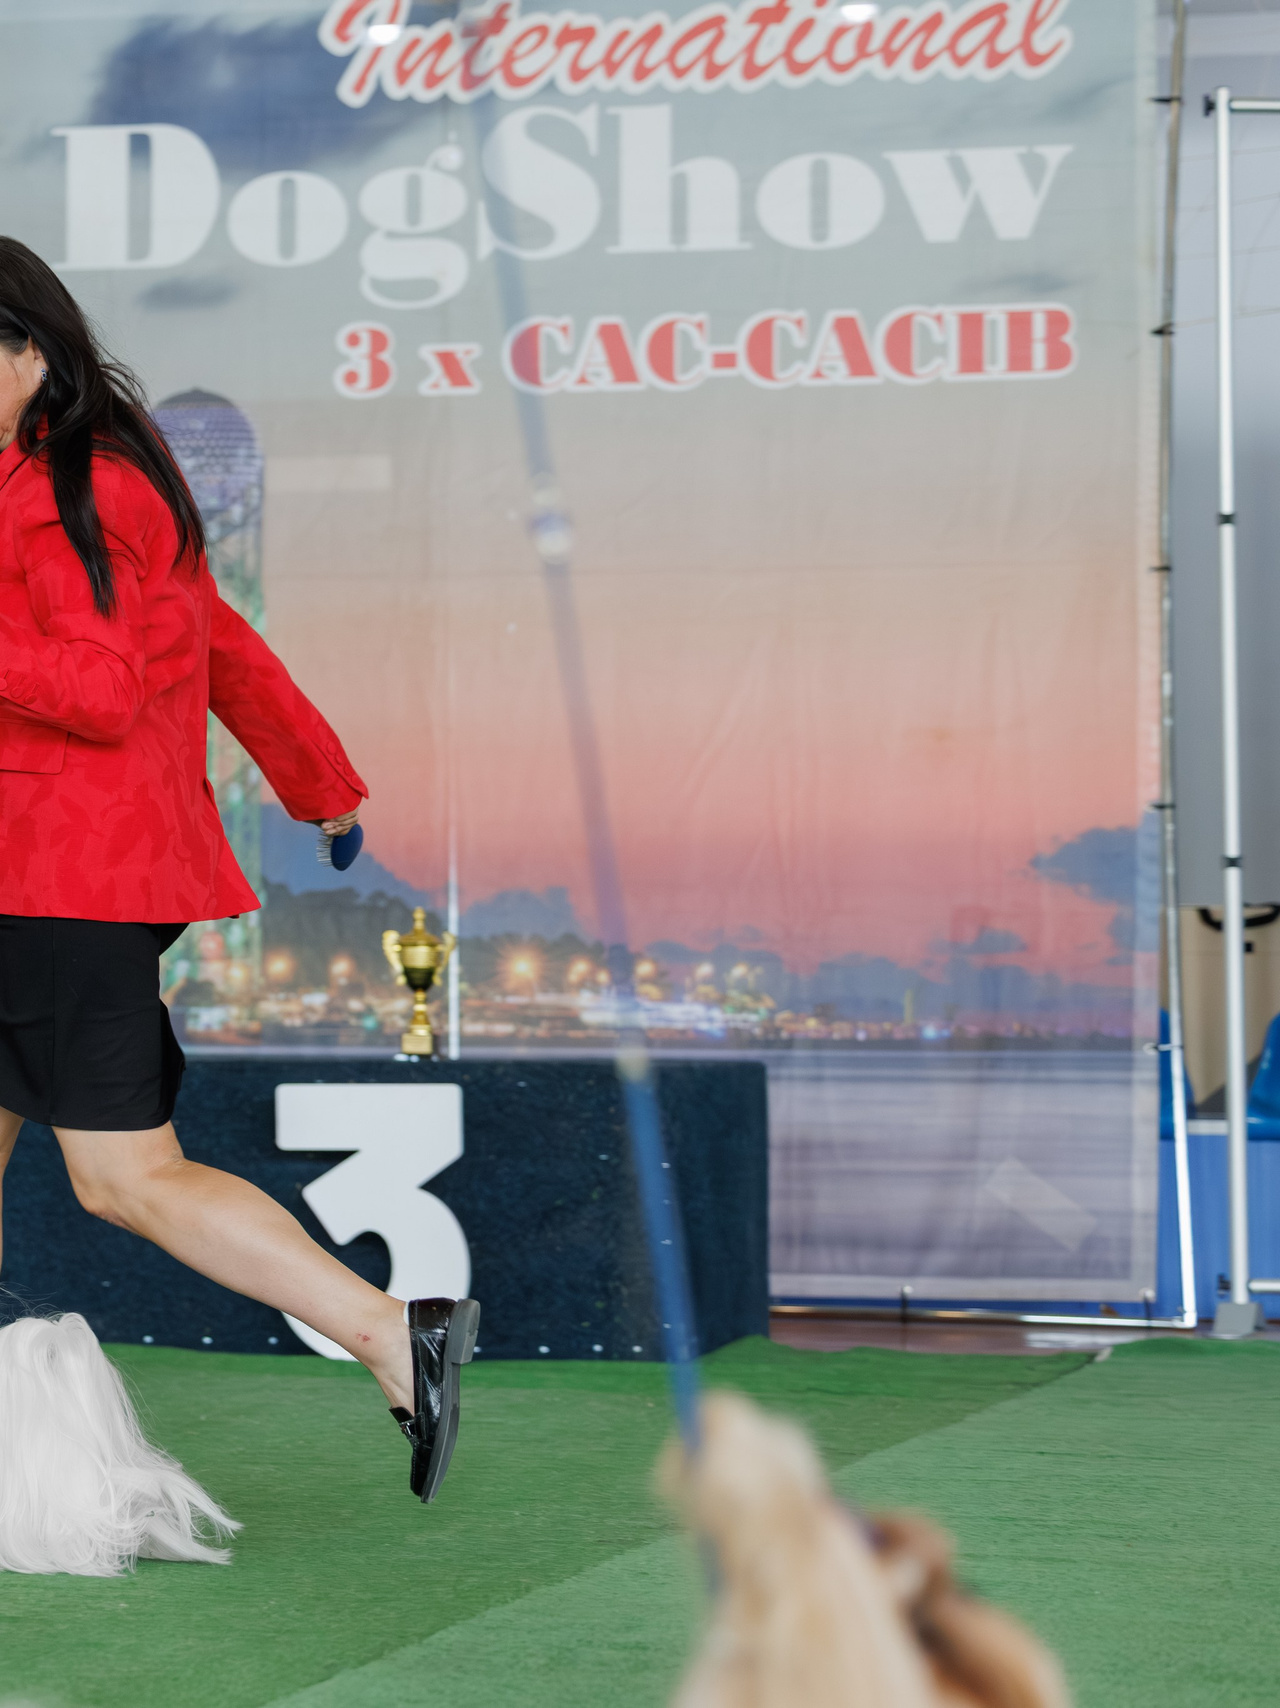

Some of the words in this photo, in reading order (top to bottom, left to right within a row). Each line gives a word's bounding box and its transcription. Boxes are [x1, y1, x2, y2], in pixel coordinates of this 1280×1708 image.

[324, 0, 1070, 106] International
[51, 104, 1074, 310] DogShow
[339, 325, 394, 396] 3
[421, 347, 481, 392] x
[507, 305, 1075, 390] CAC-CACIB
[275, 1082, 471, 1361] 3
